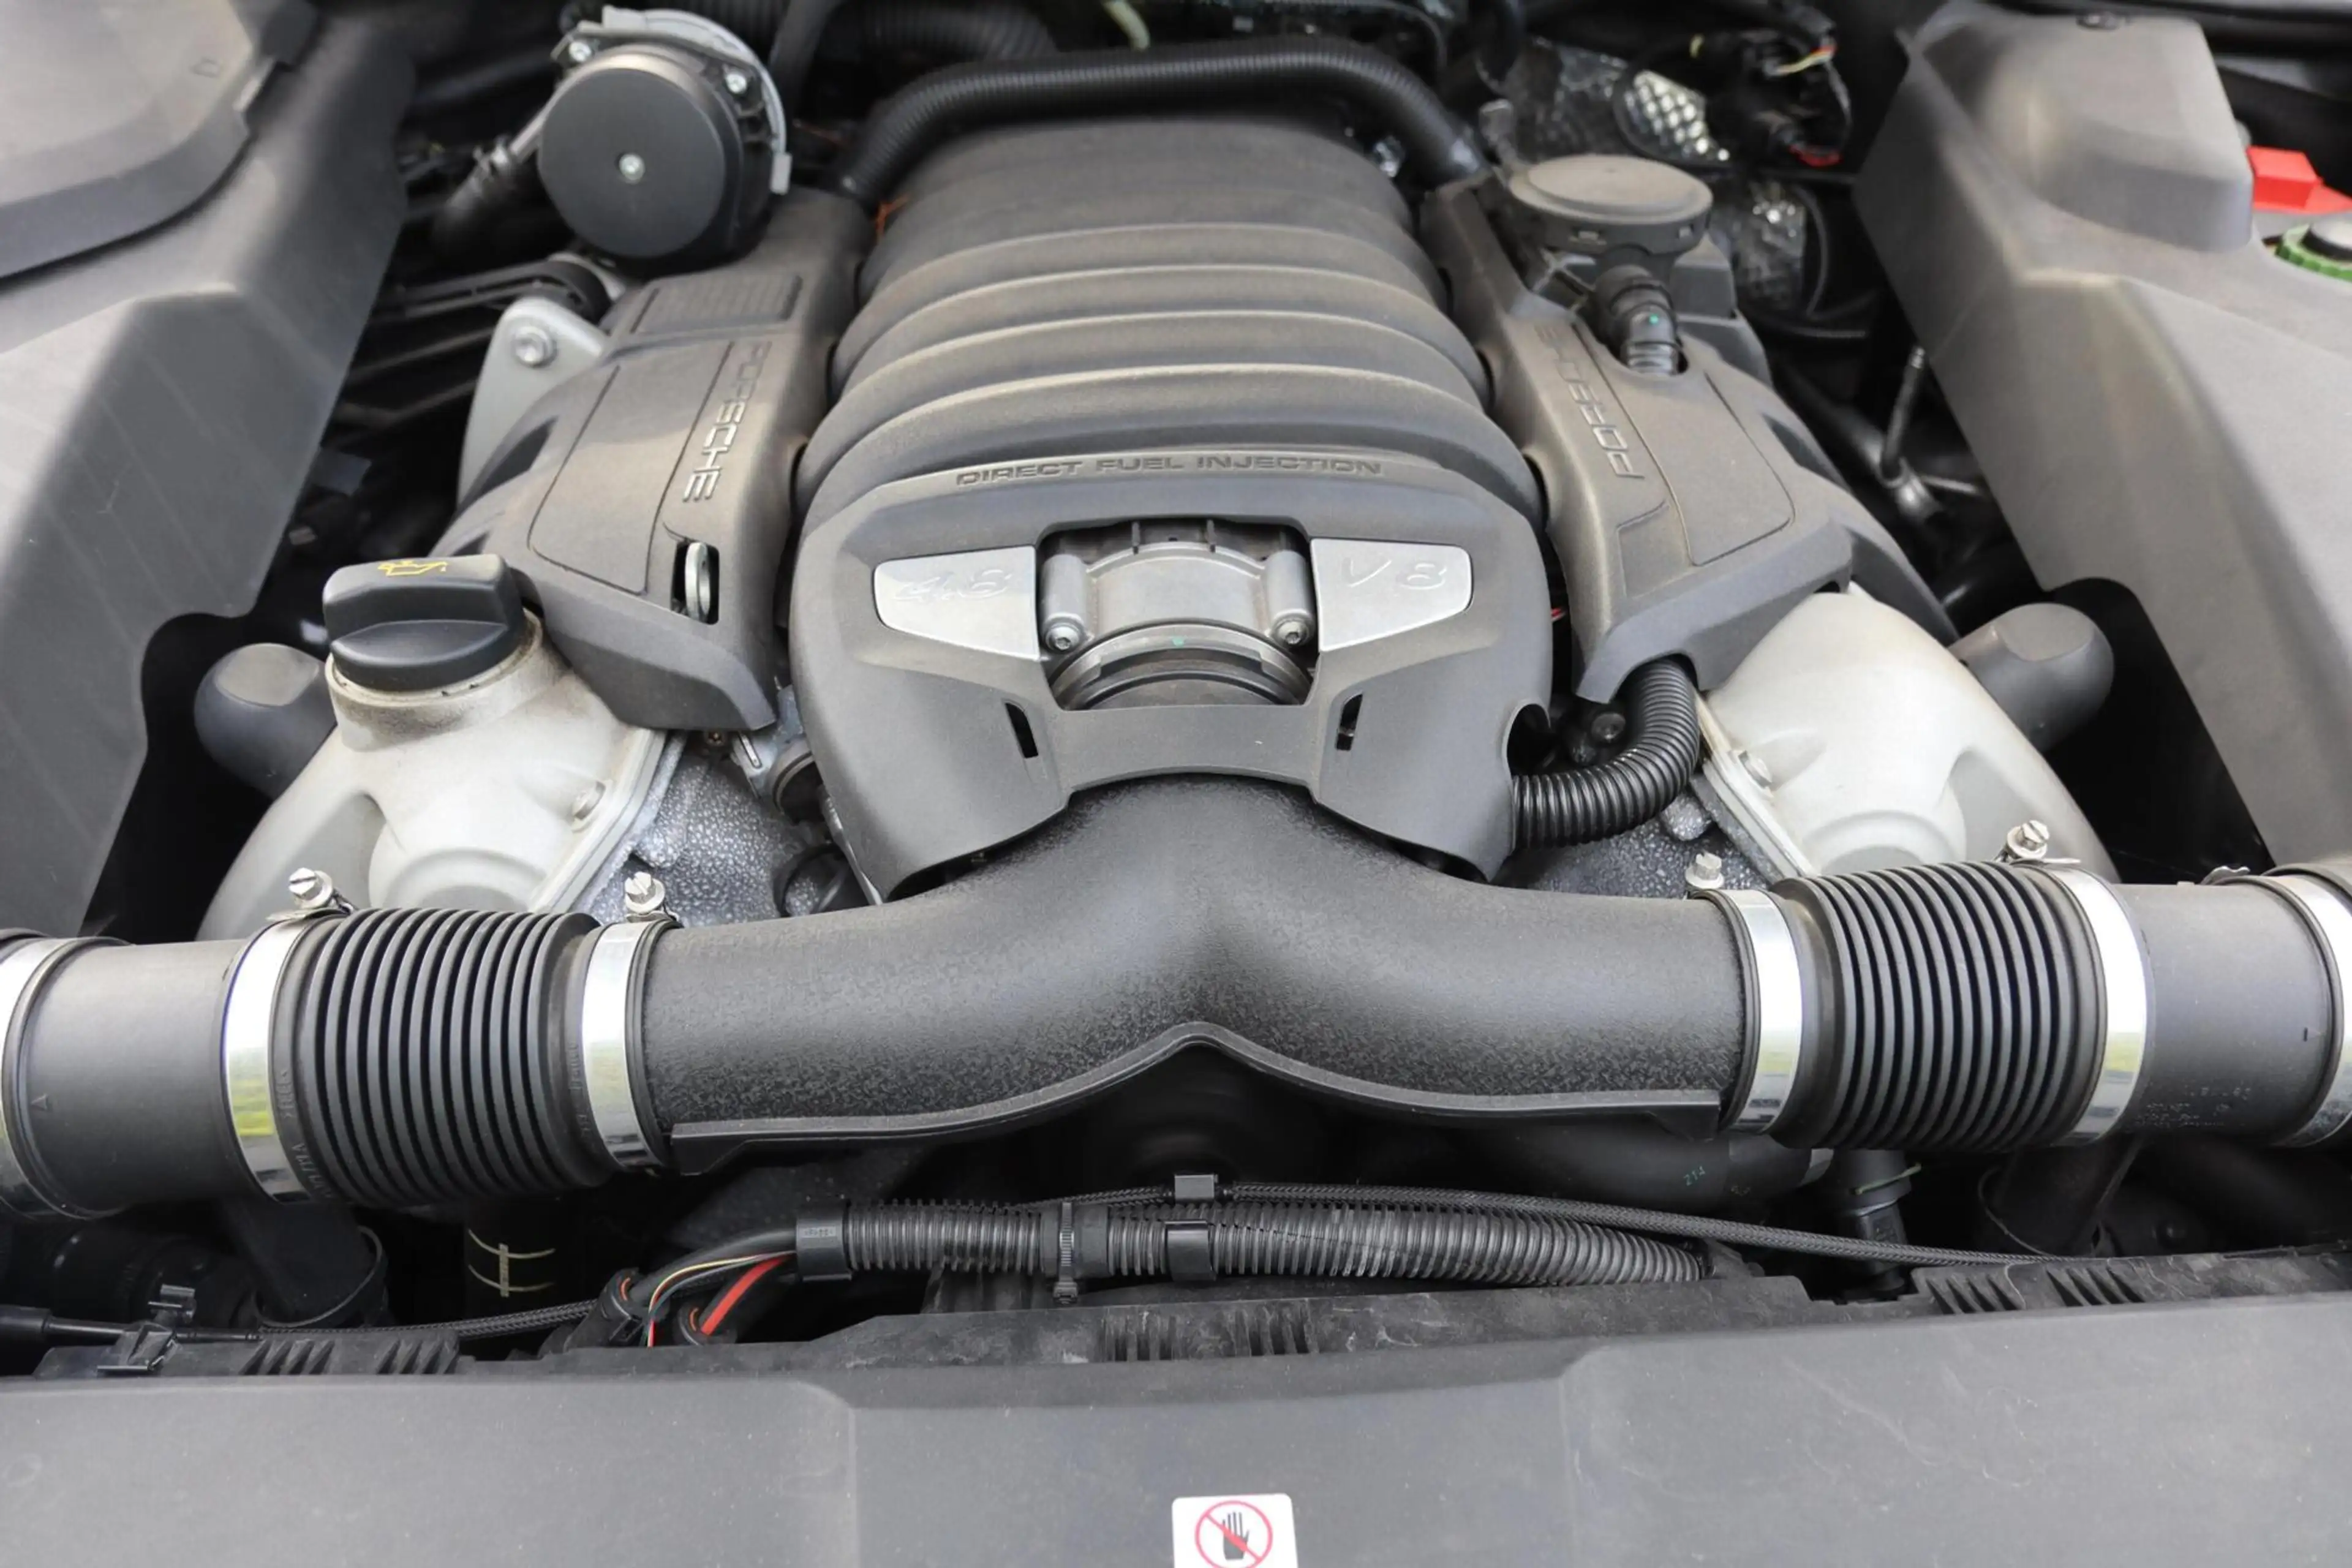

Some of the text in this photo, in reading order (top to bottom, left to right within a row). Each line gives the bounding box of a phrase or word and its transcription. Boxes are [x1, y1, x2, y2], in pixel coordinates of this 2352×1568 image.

[681, 341, 774, 502] PORSCHE
[956, 456, 1382, 486] DIRECT FUEL INJECTION
[1534, 323, 1645, 480] PORSCHE
